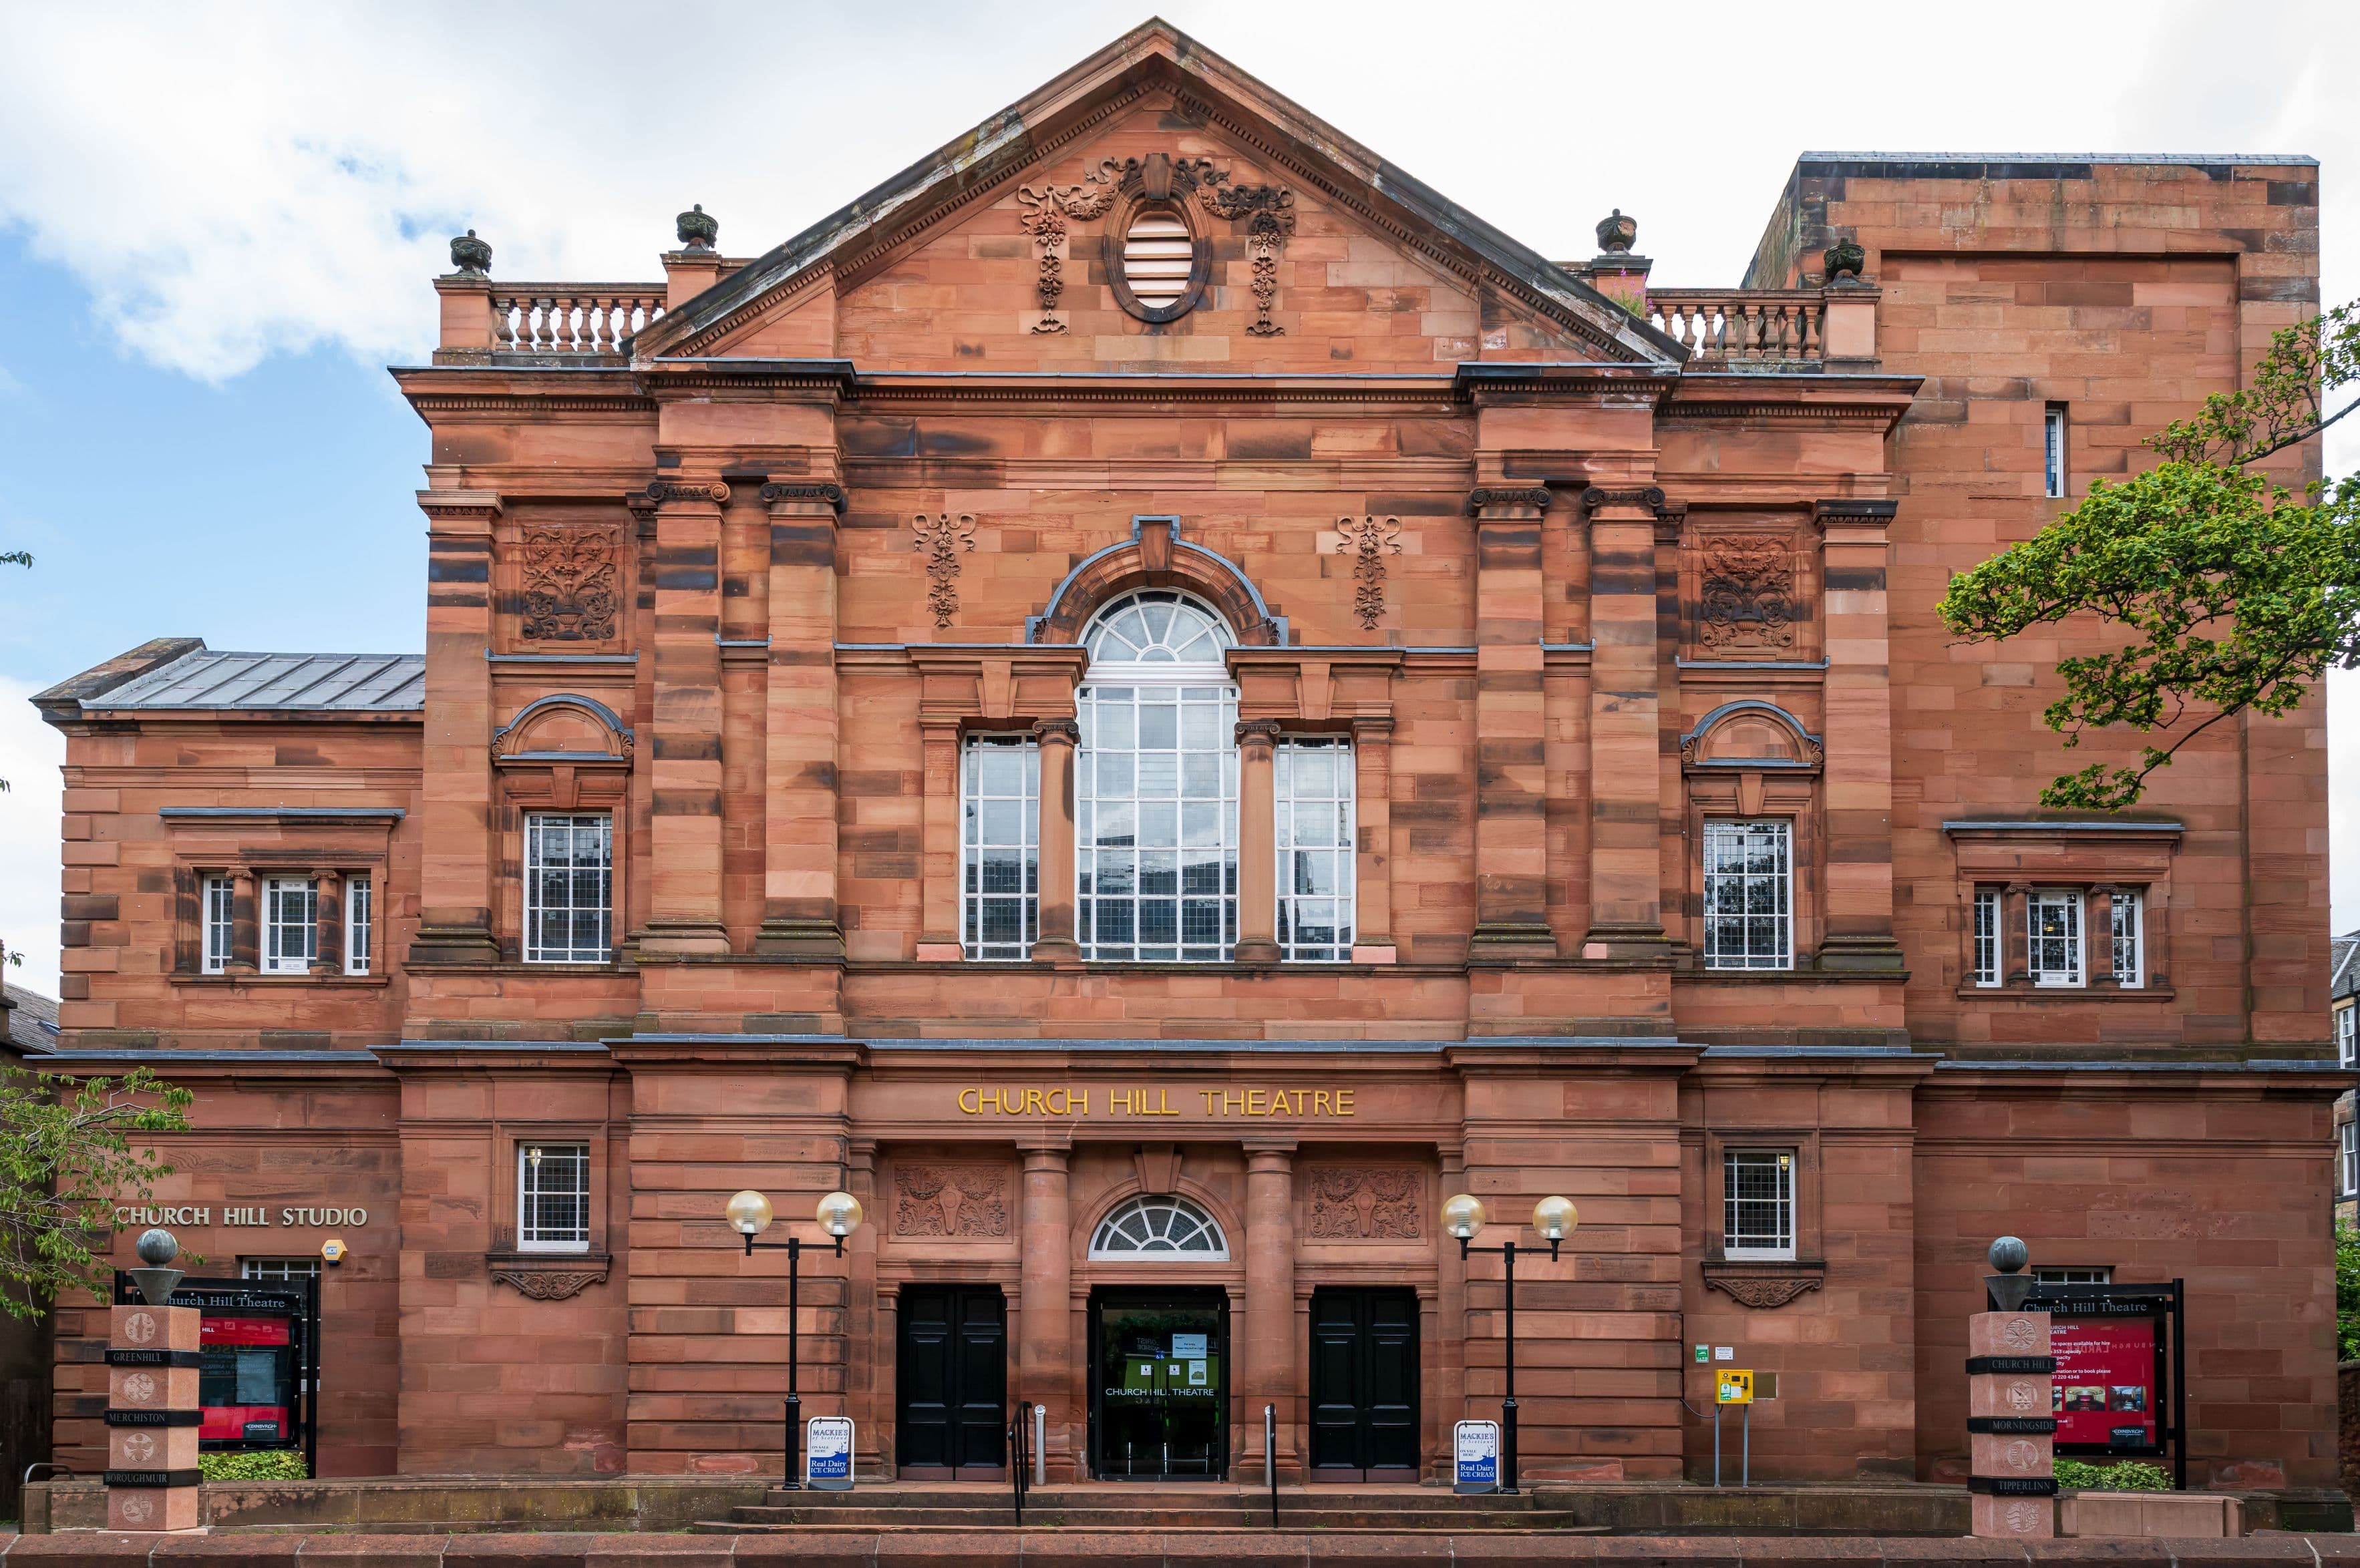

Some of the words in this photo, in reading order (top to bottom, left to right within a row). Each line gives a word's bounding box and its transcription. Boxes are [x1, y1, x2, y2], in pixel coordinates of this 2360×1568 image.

[957, 1088, 1089, 1115] CHURCH
[1110, 1089, 1180, 1116] HILL
[1199, 1089, 1355, 1116] THEATRE
[115, 1207, 210, 1225] CHURCH
[224, 1207, 270, 1225] HILL
[283, 1207, 368, 1226] STUDIO
[168, 1296, 204, 1306] hurch
[209, 1296, 234, 1306] Hill
[236, 1298, 285, 1308] Theatre
[2024, 1304, 2067, 1312] Church
[2073, 1303, 2095, 1312] Hill
[2099, 1302, 2148, 1312] Theatre
[113, 1352, 162, 1362] GREENHILL
[1992, 1360, 2030, 1369] CHURCH
[2033, 1360, 2053, 1369] HILL
[1106, 1388, 1147, 1396] CHURCH
[109, 1413, 166, 1422] MERCHISTON
[1993, 1420, 2055, 1430] MORNINGSIDE
[828, 1460, 846, 1468] Dairy
[1476, 1464, 1494, 1473] Dairy
[106, 1473, 167, 1483] BOROUGHMUIR
[1998, 1481, 2051, 1491] TIPPERLINN
